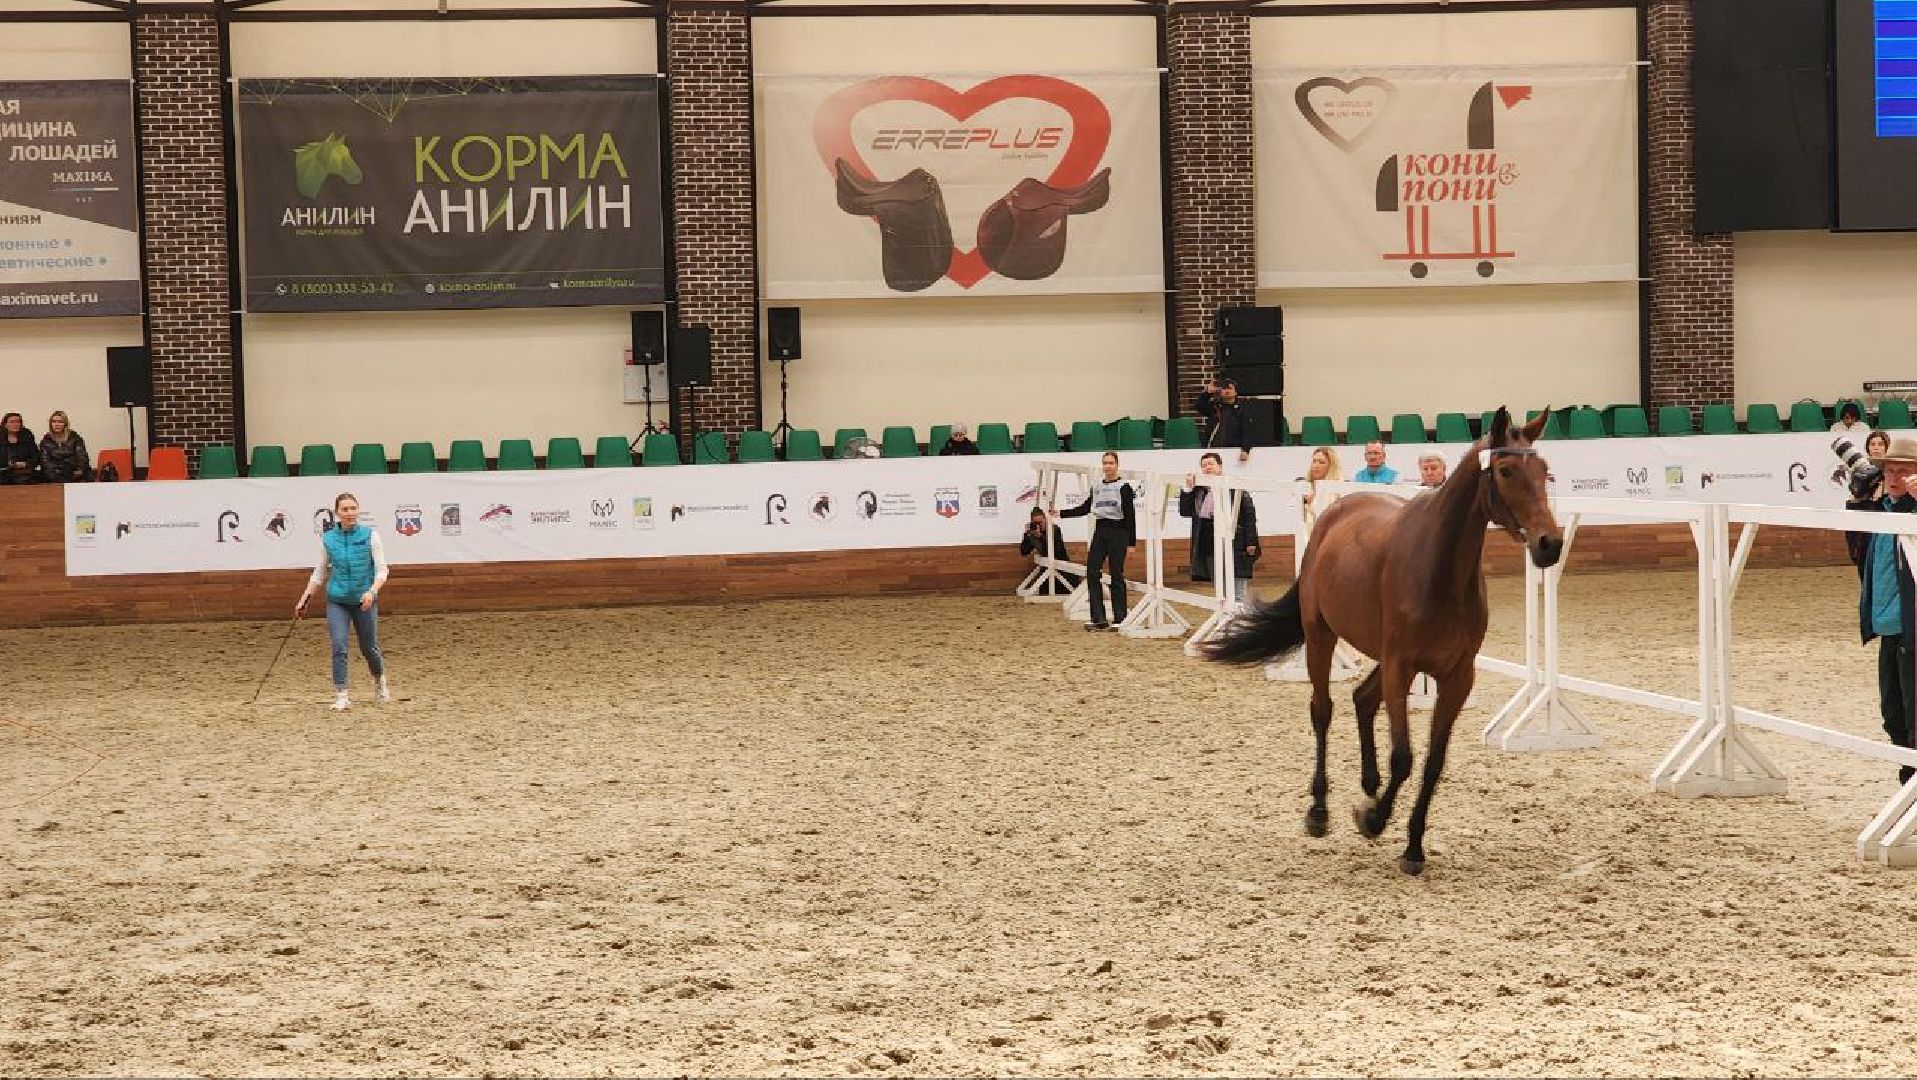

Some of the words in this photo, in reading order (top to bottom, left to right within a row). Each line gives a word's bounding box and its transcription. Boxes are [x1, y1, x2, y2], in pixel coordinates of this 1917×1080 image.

[0, 122, 77, 140] ИЦИНА
[871, 127, 1064, 150] ERREPLUS
[9, 139, 119, 163] ЛОШАДЕЙ
[414, 133, 629, 183] КОРМА
[1403, 154, 1497, 176] кони
[52, 171, 113, 183] MAXIMA
[1403, 179, 1497, 202] пони
[280, 206, 376, 227] АНИЛИН
[403, 184, 632, 234] АНИЛИН
[0, 291, 98, 305] aximavet.ru
